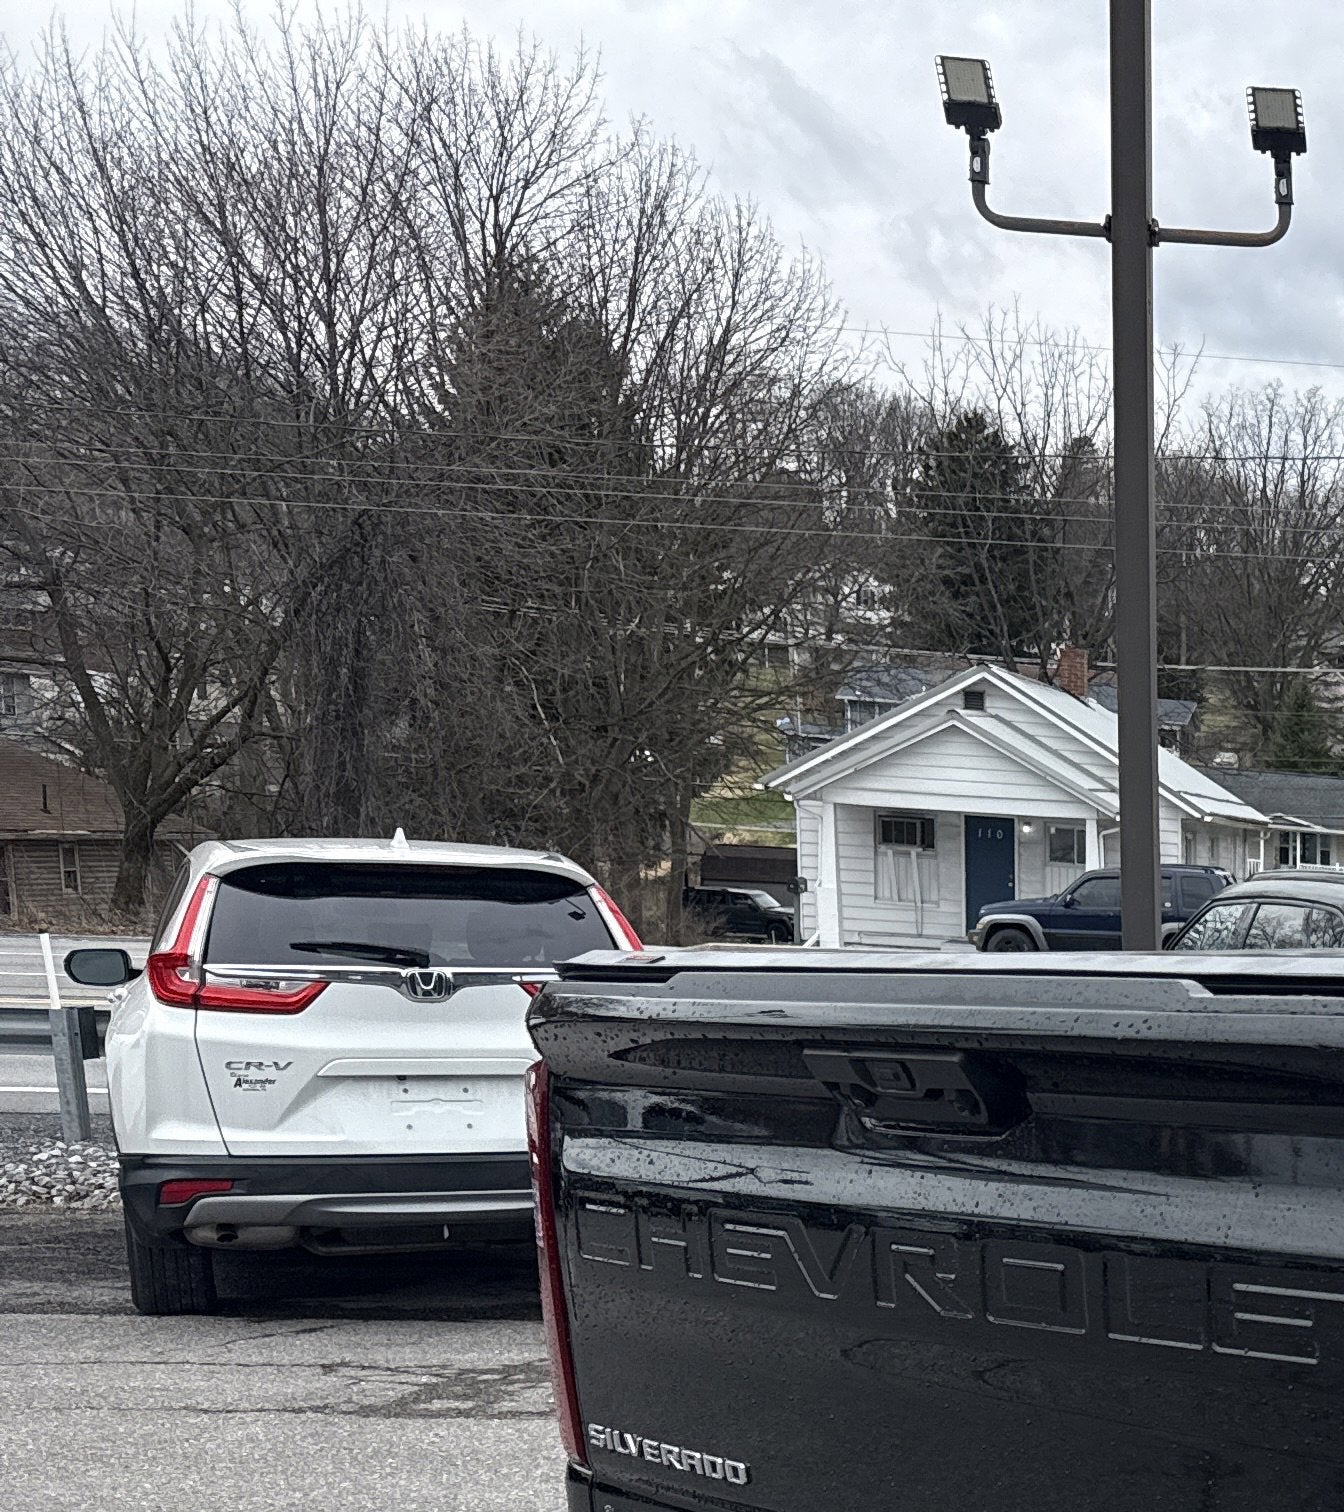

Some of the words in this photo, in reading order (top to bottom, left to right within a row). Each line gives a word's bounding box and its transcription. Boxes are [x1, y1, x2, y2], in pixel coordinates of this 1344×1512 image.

[978, 828, 1004, 840] 110
[225, 1060, 294, 1071] CR-V
[588, 1423, 750, 1485] SILVERADO
